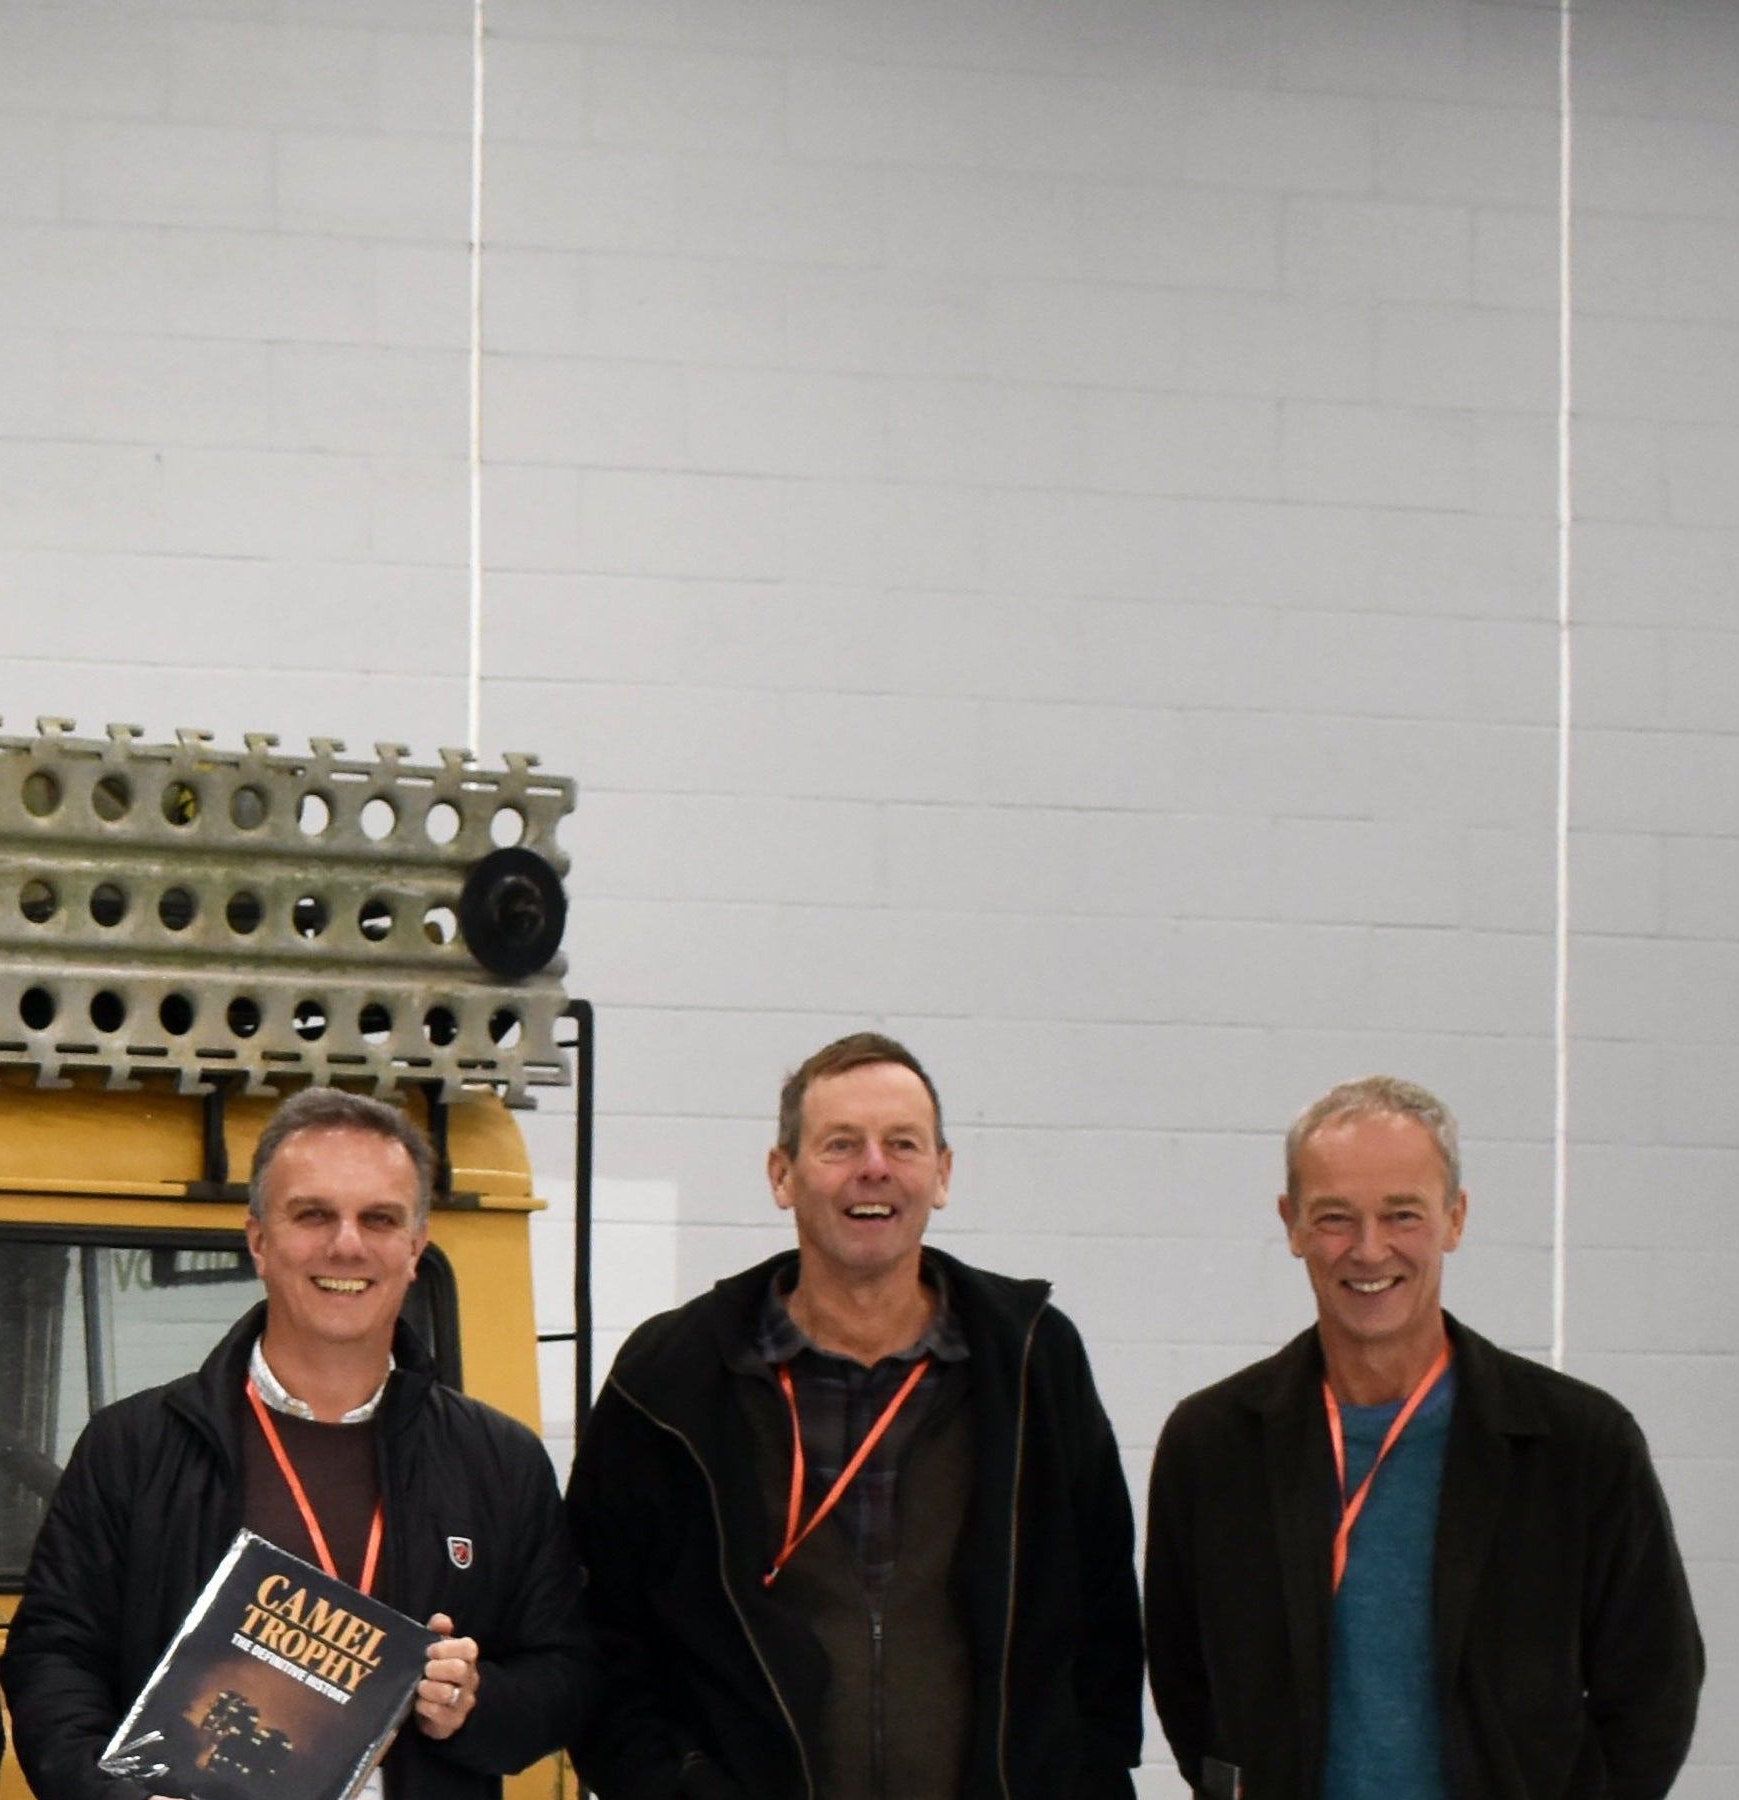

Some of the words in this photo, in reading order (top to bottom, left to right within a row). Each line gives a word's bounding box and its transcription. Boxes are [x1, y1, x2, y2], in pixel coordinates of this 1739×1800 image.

[230, 1632, 254, 1652] THE
[239, 1603, 373, 1692] TROPHY
[257, 1574, 387, 1667] CAMEL
